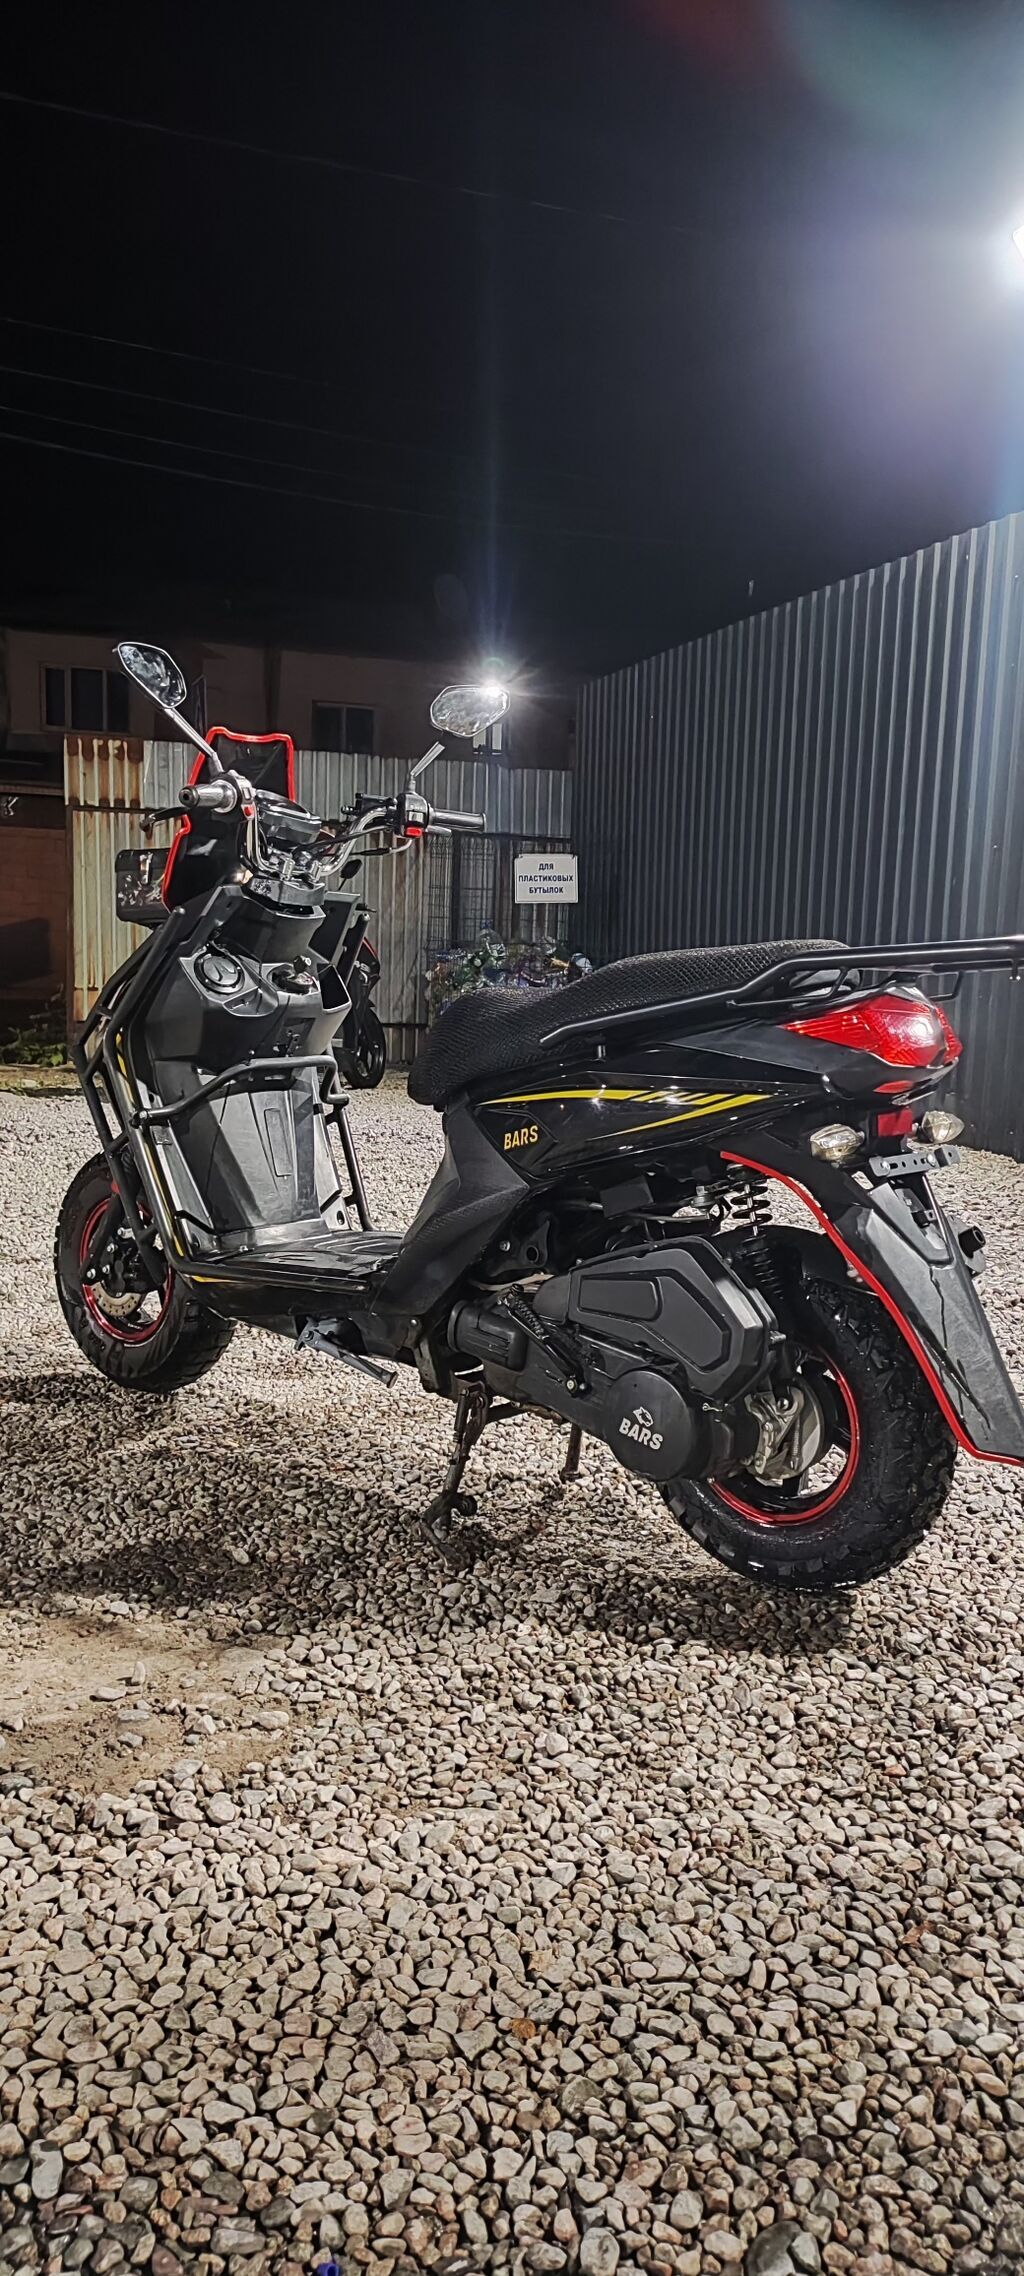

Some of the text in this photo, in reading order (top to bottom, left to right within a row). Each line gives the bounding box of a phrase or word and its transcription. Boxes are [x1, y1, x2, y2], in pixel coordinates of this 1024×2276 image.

[539, 863, 554, 871] ДЛЯ
[504, 1125, 539, 1150] BARS
[619, 1417, 663, 1450] BARS
